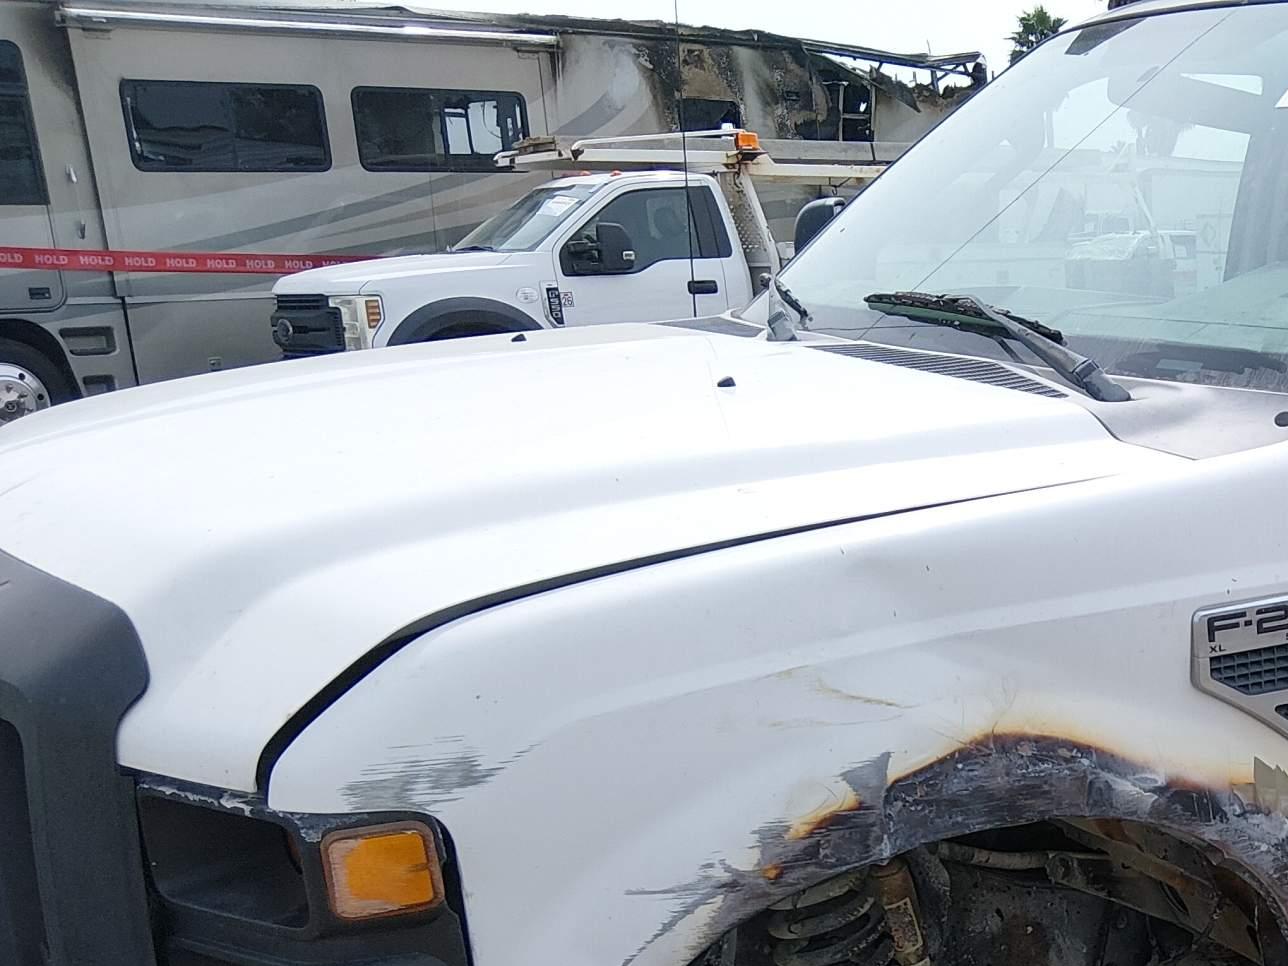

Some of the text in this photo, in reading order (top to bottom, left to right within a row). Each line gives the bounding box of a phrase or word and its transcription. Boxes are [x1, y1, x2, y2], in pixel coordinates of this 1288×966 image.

[0, 253, 24, 263] OLD
[35, 254, 68, 265] HOLD
[79, 255, 114, 265] HOLD
[124, 256, 156, 267] HOLD
[166, 258, 197, 268] HOLD
[207, 258, 237, 269] HOLD
[246, 259, 276, 269] HOLD
[285, 260, 313, 270] HOLD
[561, 296, 574, 306] 26
[1209, 644, 1226, 654] XL
